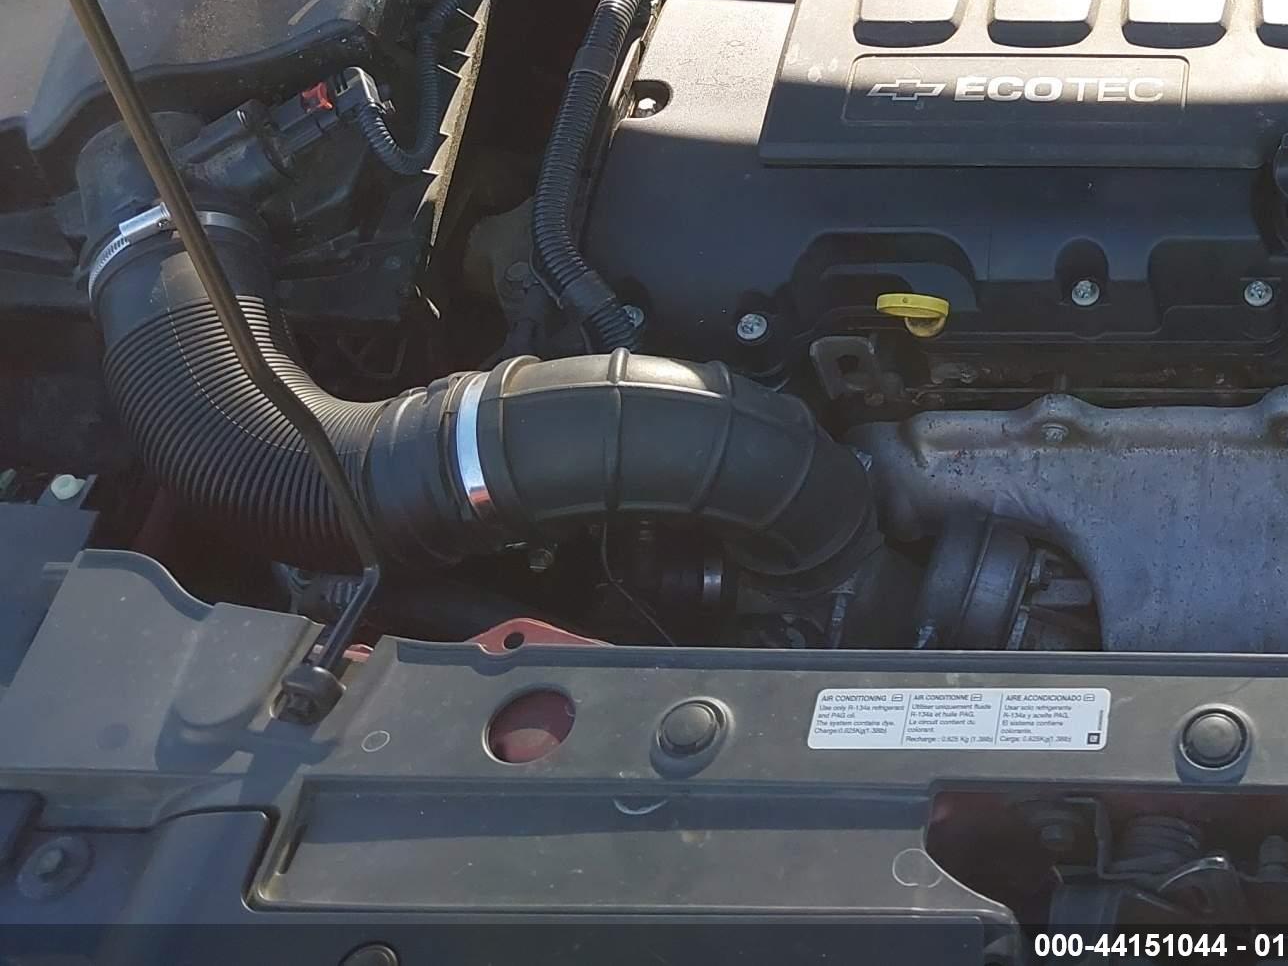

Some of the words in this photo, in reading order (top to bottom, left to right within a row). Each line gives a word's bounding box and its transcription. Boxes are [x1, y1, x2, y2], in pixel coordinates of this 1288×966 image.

[954, 76, 1165, 102] ECOTEC
[821, 694, 834, 702] AIR
[835, 694, 888, 702] CONDITIONING
[1006, 694, 1022, 702] AIRE
[1023, 694, 1082, 702] ACONDICIONADO
